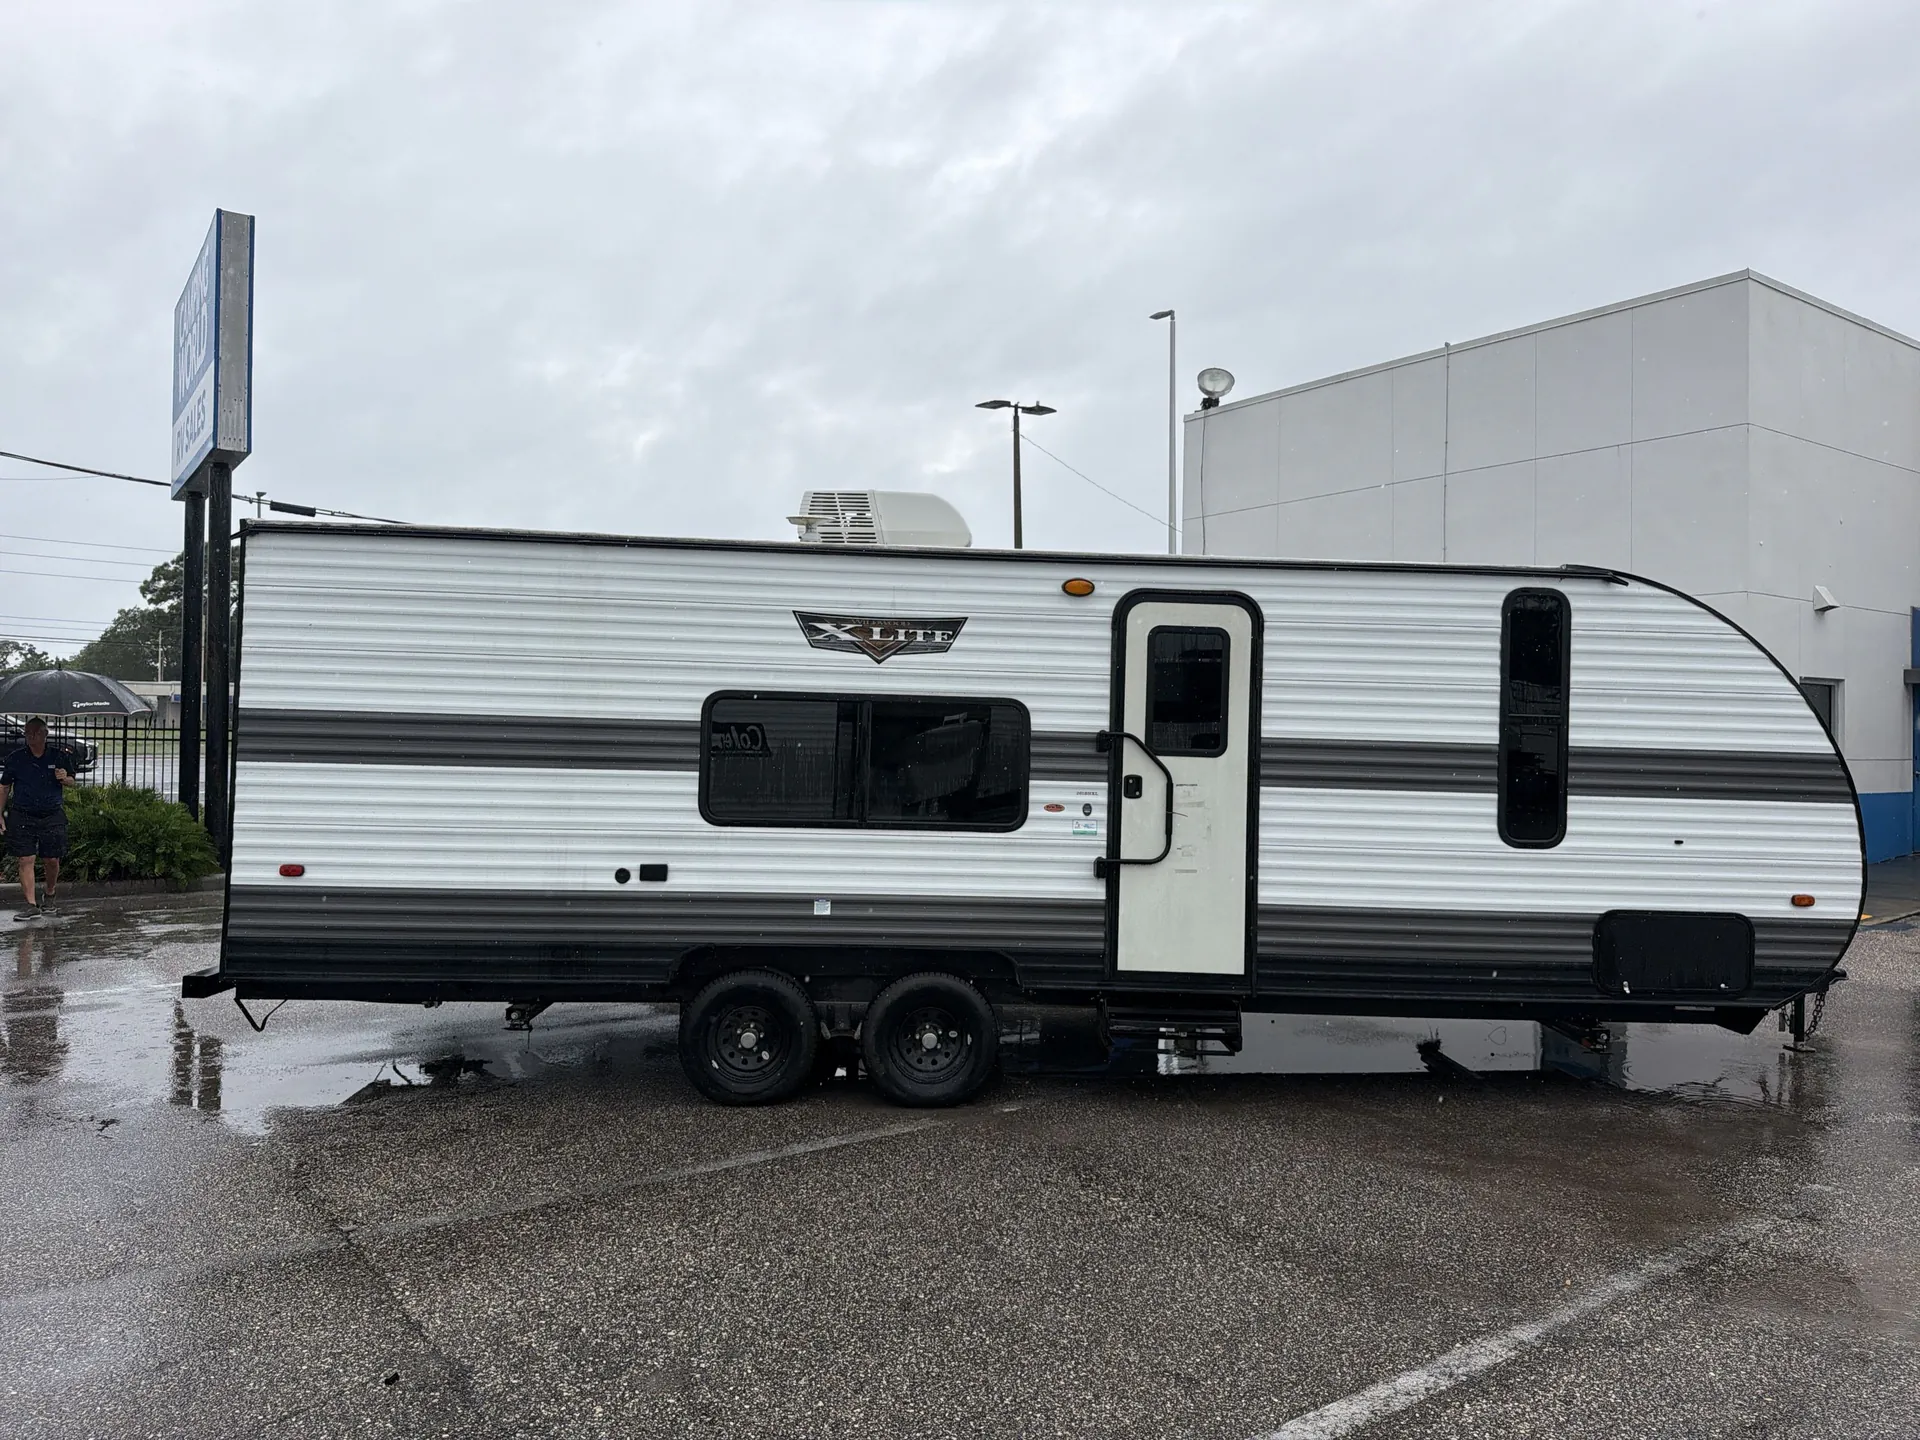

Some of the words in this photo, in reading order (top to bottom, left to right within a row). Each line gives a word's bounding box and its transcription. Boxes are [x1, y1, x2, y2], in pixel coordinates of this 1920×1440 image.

[179, 243, 209, 348] CAMPING
[178, 301, 208, 403] WORLD
[176, 421, 186, 467] RV
[186, 389, 206, 453] SALES
[869, 627, 953, 643] LITE
